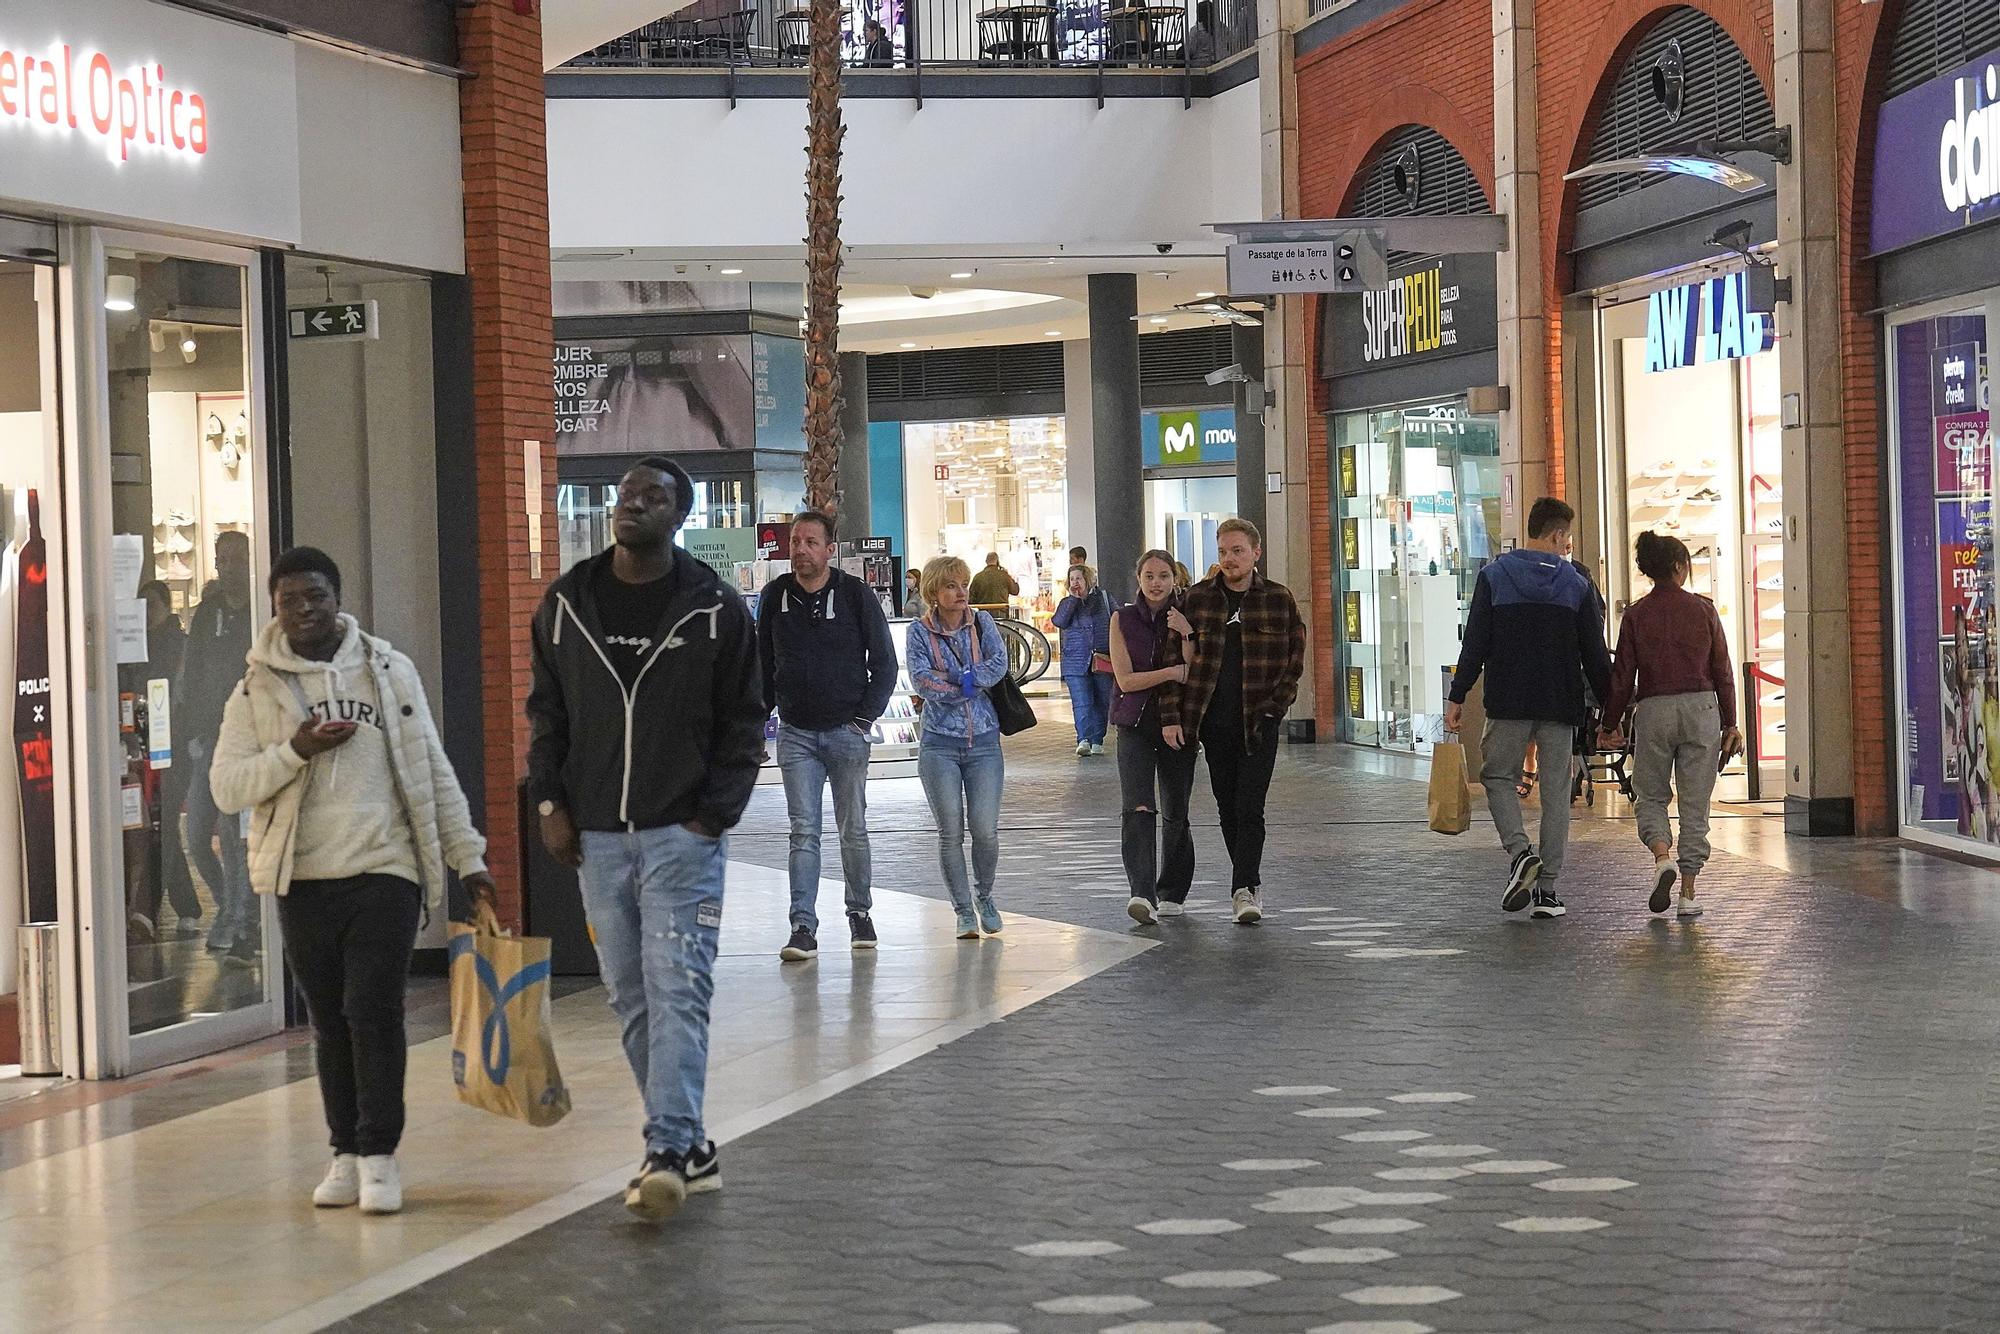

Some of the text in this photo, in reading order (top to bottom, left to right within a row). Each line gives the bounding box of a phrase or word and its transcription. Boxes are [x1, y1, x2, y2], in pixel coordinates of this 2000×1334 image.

[89, 53, 207, 160] Optica
[1940, 63, 2000, 212] dai
[1248, 248, 1327, 260] Passatge de la Terra
[1440, 285, 1460, 303] BELLEZA
[1440, 308, 1453, 325] PARA
[1645, 284, 1691, 373] AW
[1945, 421, 1978, 430] COMPRA
[1980, 421, 1984, 429] 3
[862, 539, 885, 549] UAG
